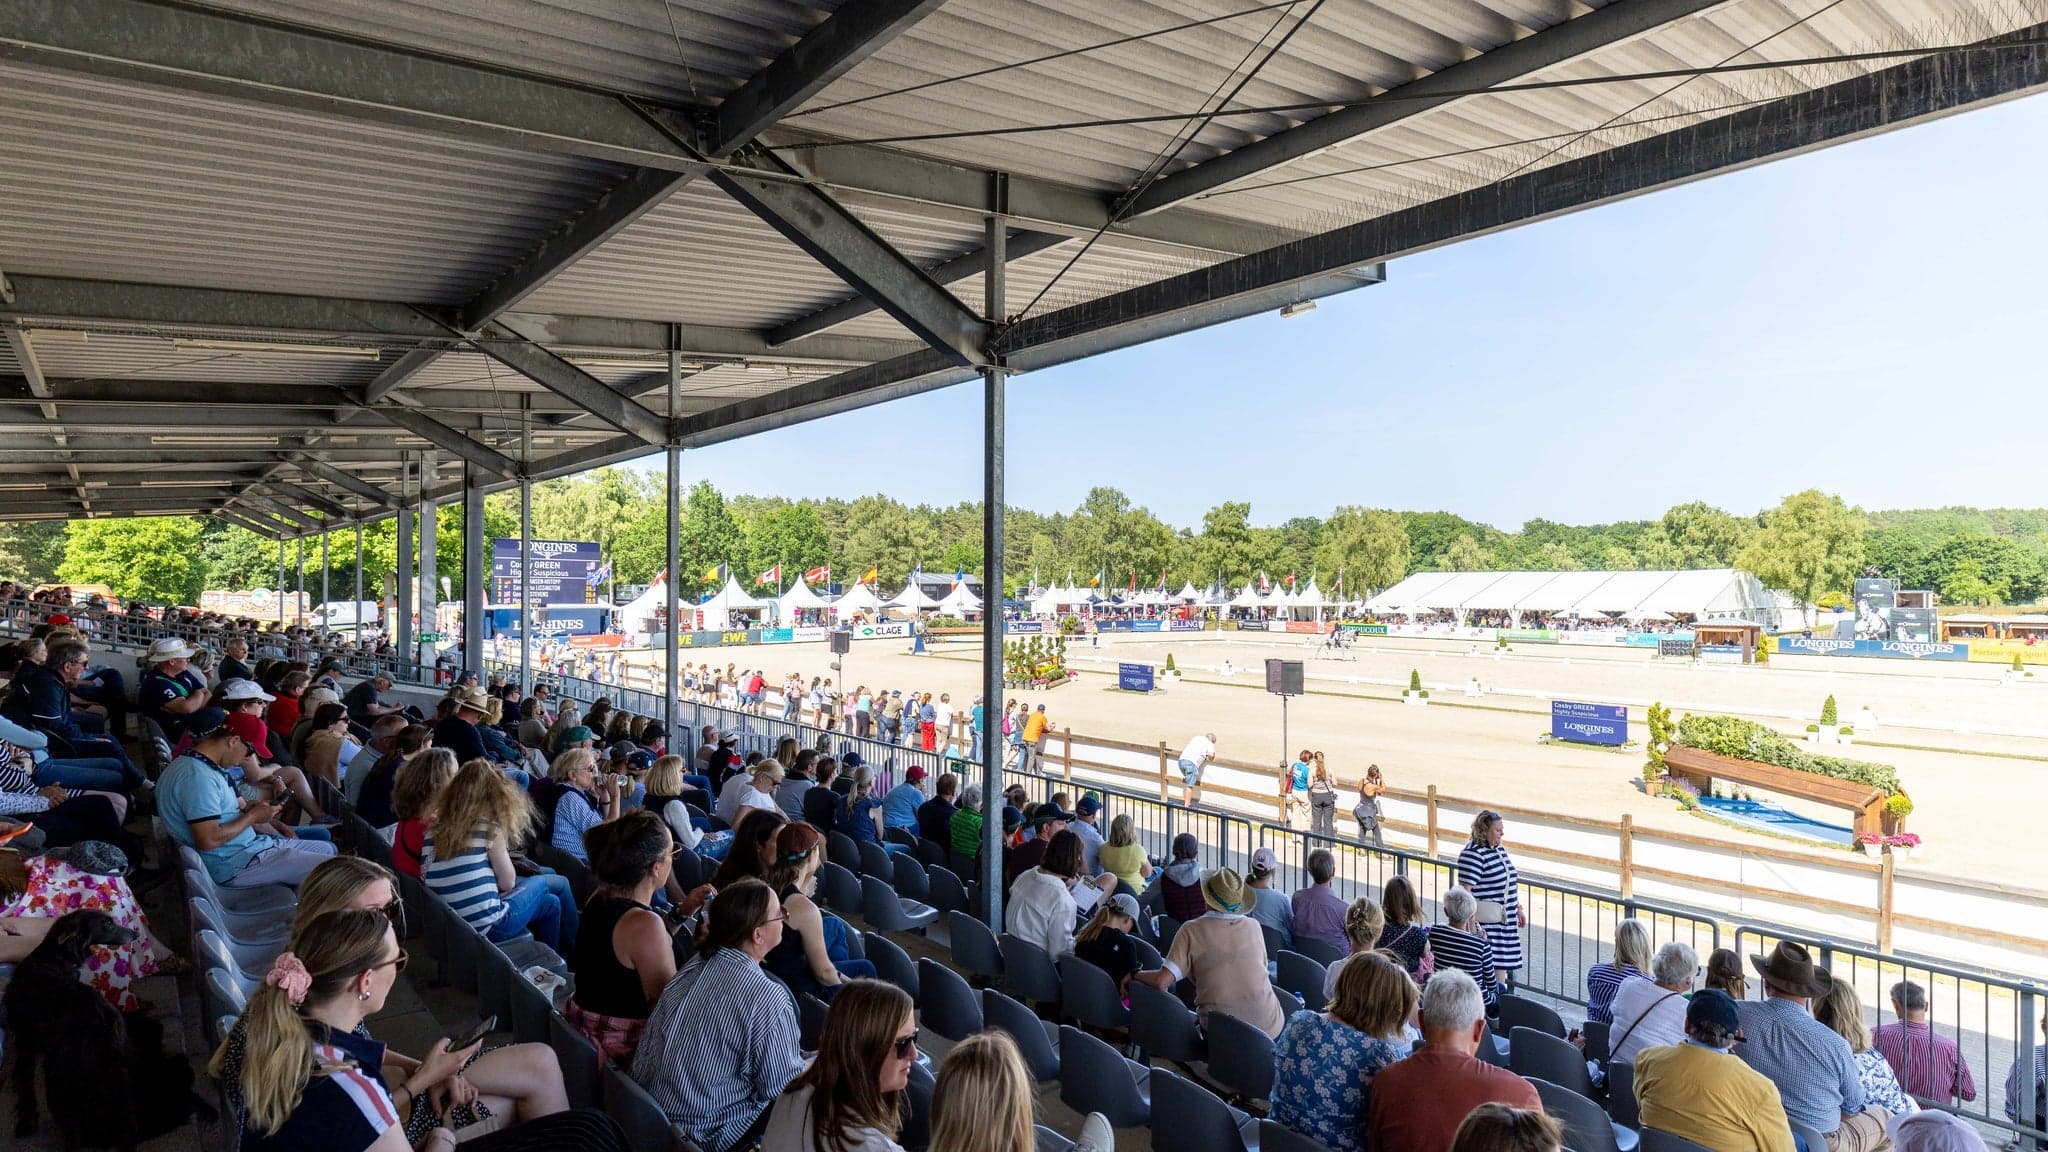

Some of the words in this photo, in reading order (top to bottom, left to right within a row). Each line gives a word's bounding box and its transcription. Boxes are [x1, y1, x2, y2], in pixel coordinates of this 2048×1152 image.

[534, 561, 560, 569] GREEN
[533, 569, 568, 578] Suspicious
[1171, 620, 1198, 628] ELLING
[875, 626, 902, 635] CLAGE
[678, 634, 693, 645] WE
[722, 632, 747, 643] EWE
[1790, 638, 1855, 649] LONGINES
[1882, 641, 1954, 653] LONGINES
[163, 688, 176, 699] 3
[1573, 703, 1595, 711] GREEN
[1564, 722, 1614, 735] LONGINES
